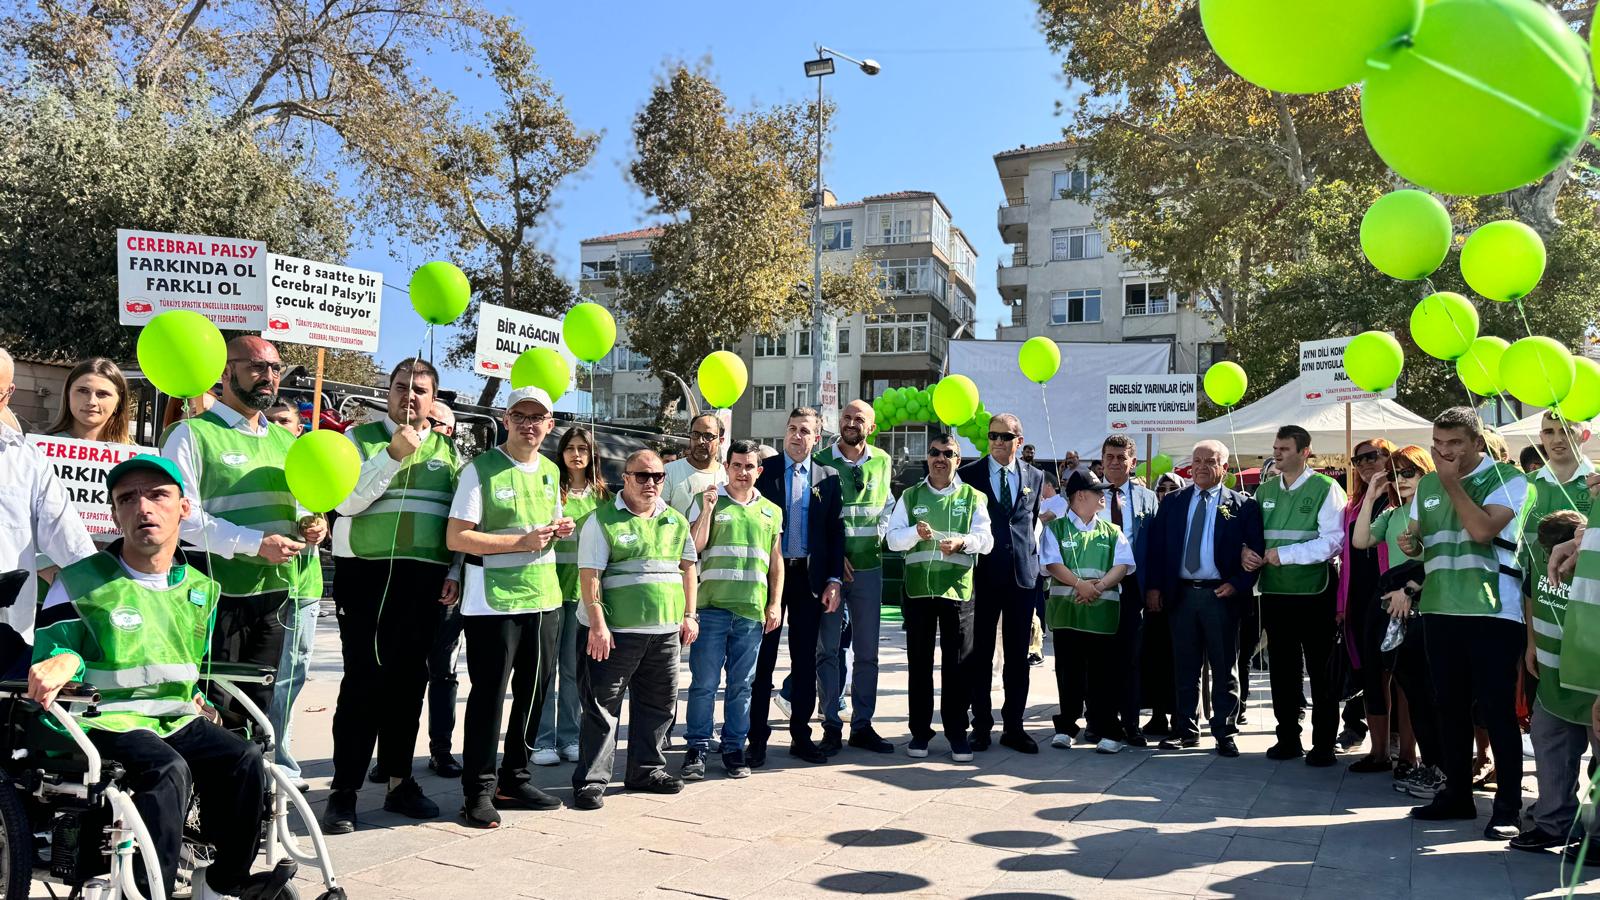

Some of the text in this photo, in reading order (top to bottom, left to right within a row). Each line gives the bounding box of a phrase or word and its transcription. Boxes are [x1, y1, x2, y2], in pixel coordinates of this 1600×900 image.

[127, 236, 258, 259] CEREBRAL PALSY
[129, 256, 257, 278] FARKINDA OL
[274, 258, 376, 288] Her 8 saatte bir
[146, 277, 242, 296] FARKLI OL
[271, 275, 328, 296] Cerebral
[275, 295, 371, 319] çocuk doğuyor
[497, 317, 560, 345] BİR AĞACIN
[1303, 349, 1317, 359] AYNI
[1318, 346, 1329, 358] DİLİ
[1301, 359, 1345, 371] AYNI DUYGULA
[1109, 381, 1194, 396] ENGELSİZ YARINLAR İÇİN
[1108, 400, 1195, 412] GELİN BİRLİKTE YÜRÜYELİM
[86, 524, 107, 534] REBRAL
